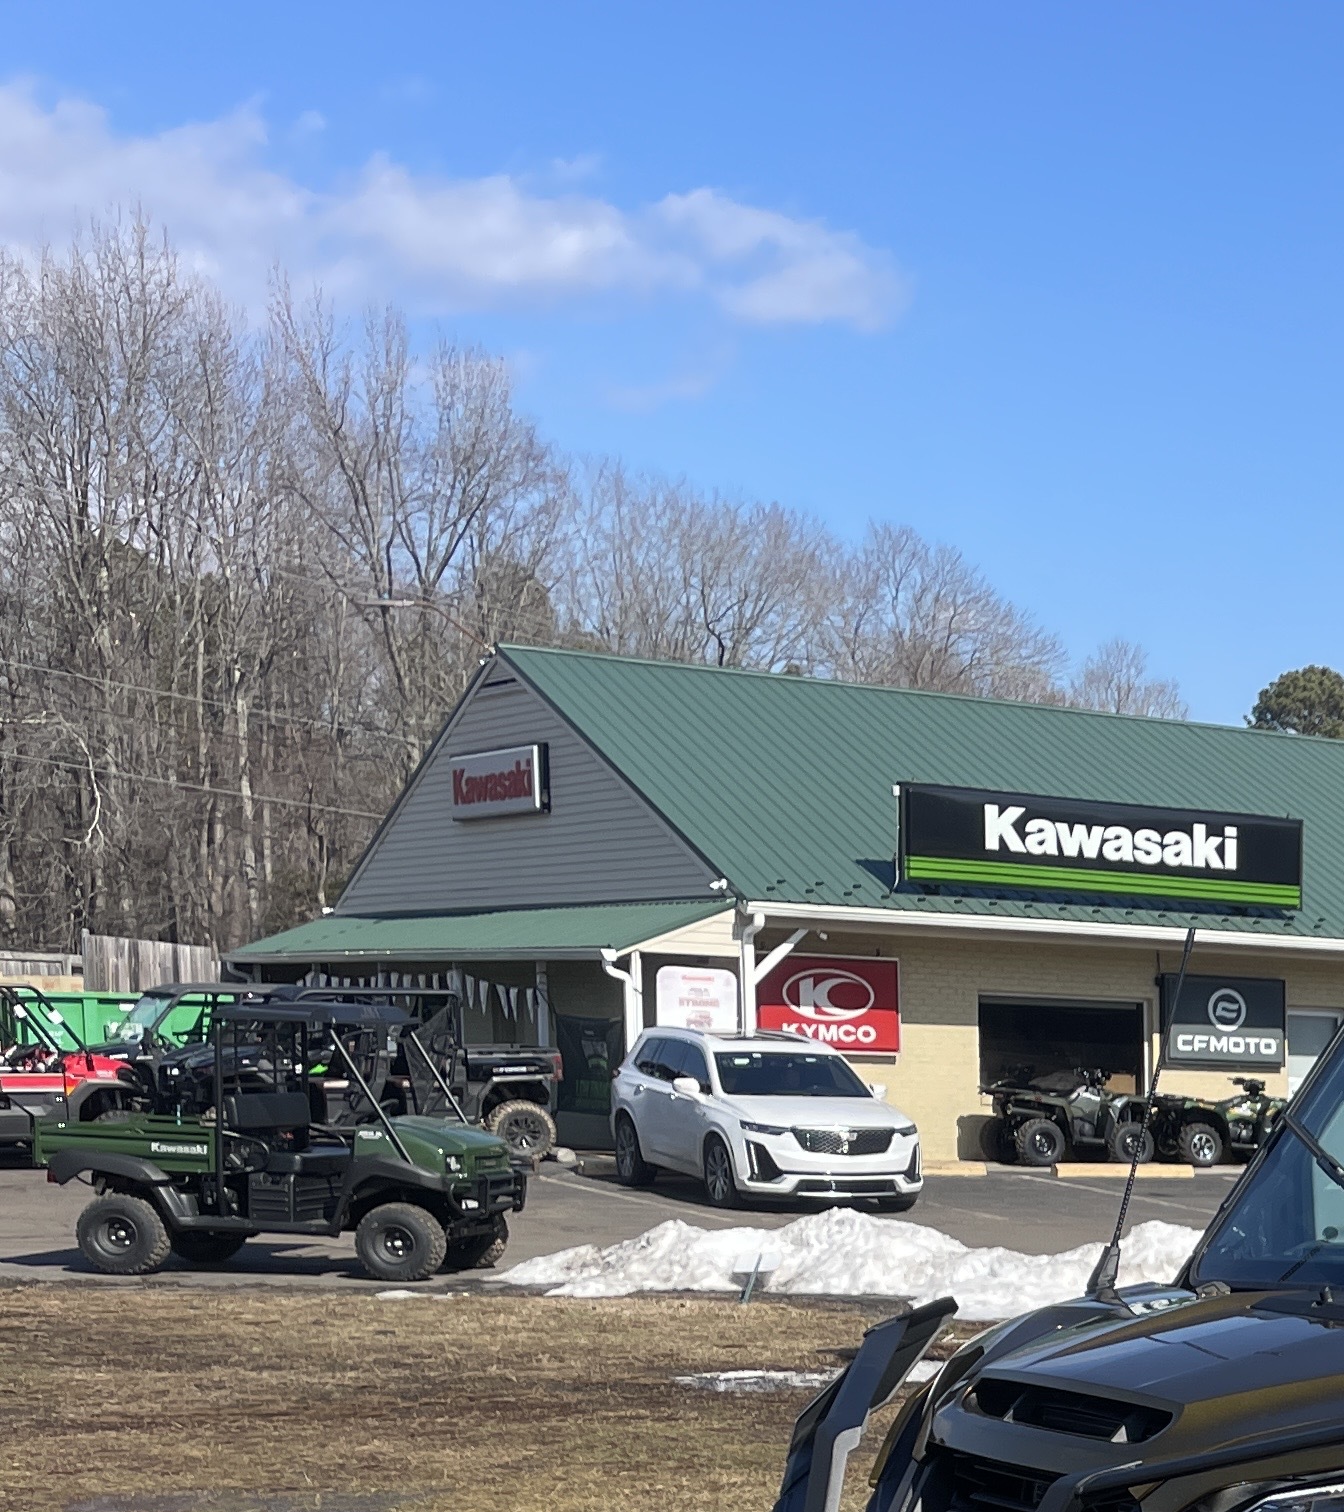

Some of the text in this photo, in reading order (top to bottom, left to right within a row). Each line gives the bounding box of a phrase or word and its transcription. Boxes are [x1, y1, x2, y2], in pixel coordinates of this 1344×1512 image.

[452, 758, 533, 806] Kawasaki
[983, 804, 1239, 872] Kawasaki
[781, 1022, 877, 1044] KYMCO
[1177, 1033, 1278, 1056] CFMOTO
[151, 1142, 208, 1155] Kawasaki
